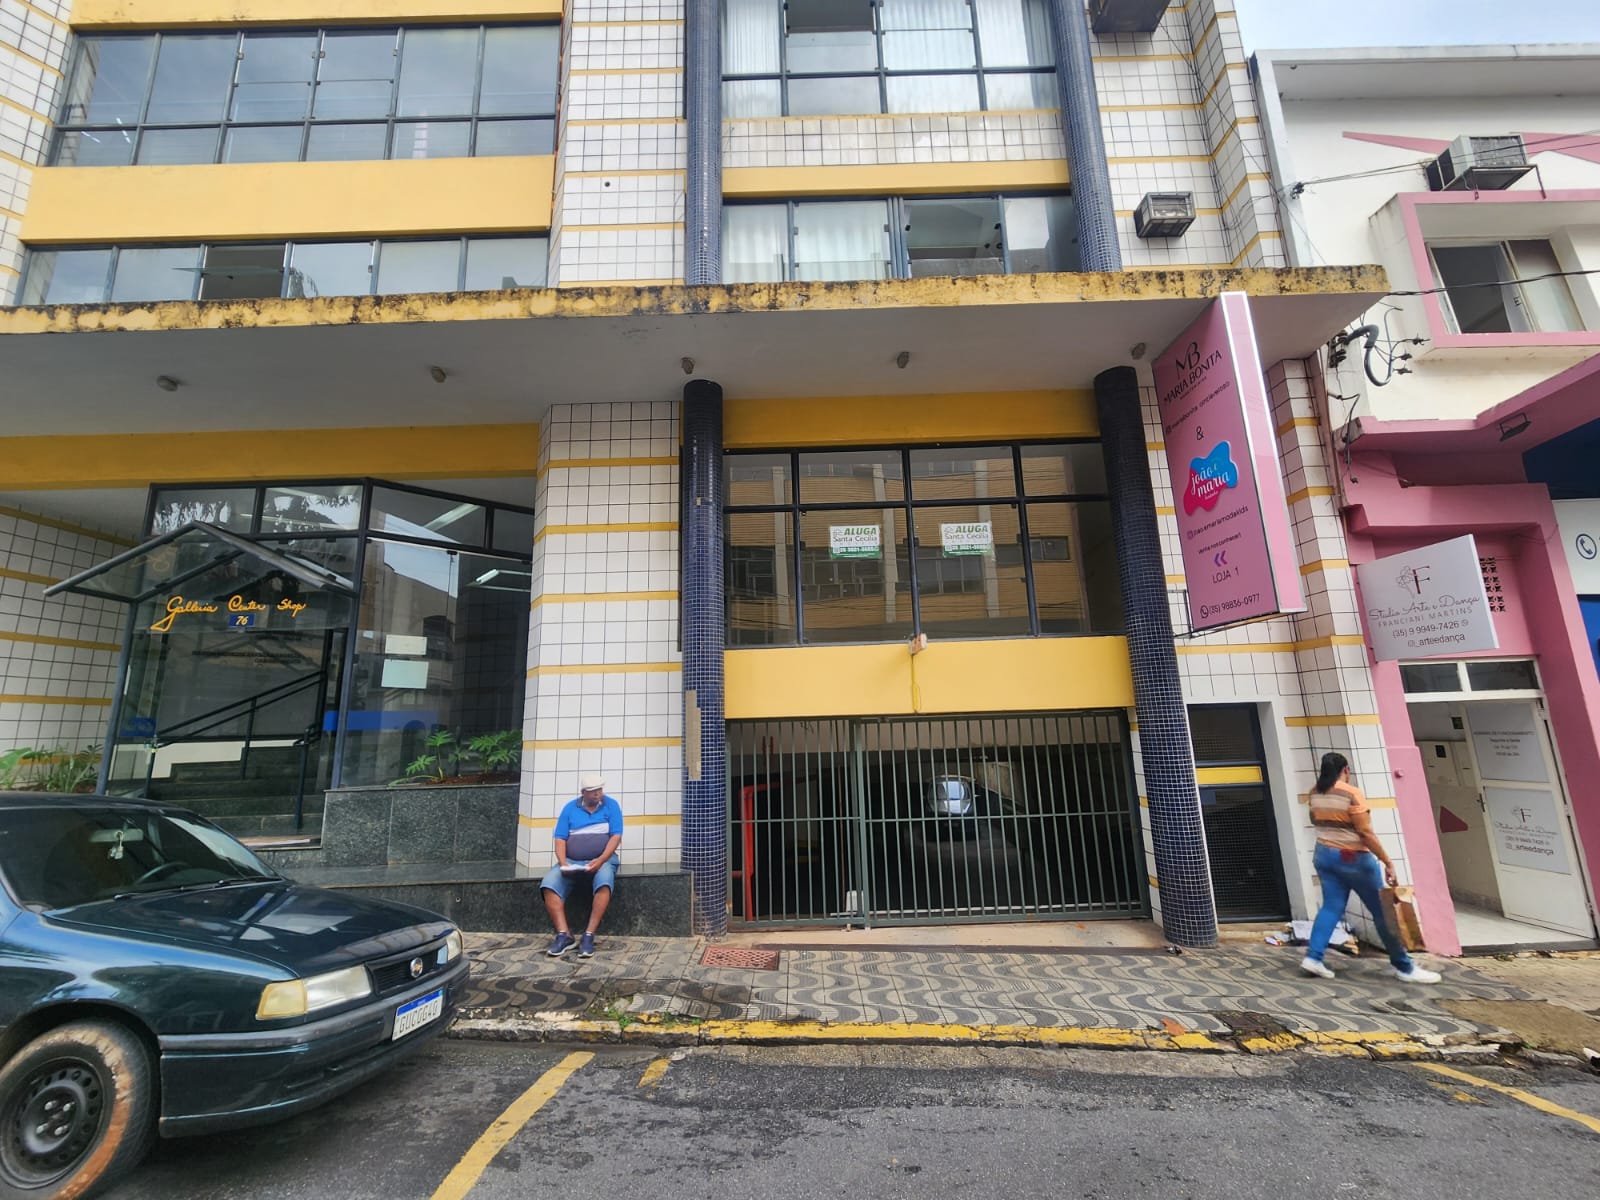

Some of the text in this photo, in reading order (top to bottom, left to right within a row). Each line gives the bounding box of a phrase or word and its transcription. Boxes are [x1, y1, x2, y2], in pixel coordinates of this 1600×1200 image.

[1163, 377, 1190, 405] MARIA
[1189, 349, 1223, 384] BONITA
[1196, 425, 1205, 441] &
[1197, 469, 1230, 498] maria
[844, 527, 877, 536] ALUGA
[955, 525, 988, 533] ALUGA
[833, 535, 853, 543] Santa
[1212, 567, 1240, 584] LOJA 1
[277, 598, 308, 618] Shop
[1221, 594, 1261, 611] 98836-0977
[1368, 606, 1402, 621] Studio
[1402, 601, 1431, 615] Arte
[1438, 594, 1481, 609] Dança
[235, 615, 249, 626] 76
[1378, 606, 1474, 628] FRANCIANI MARTINS
[1392, 628, 1408, 639] (35)
[1416, 619, 1460, 634] 9949-7426
